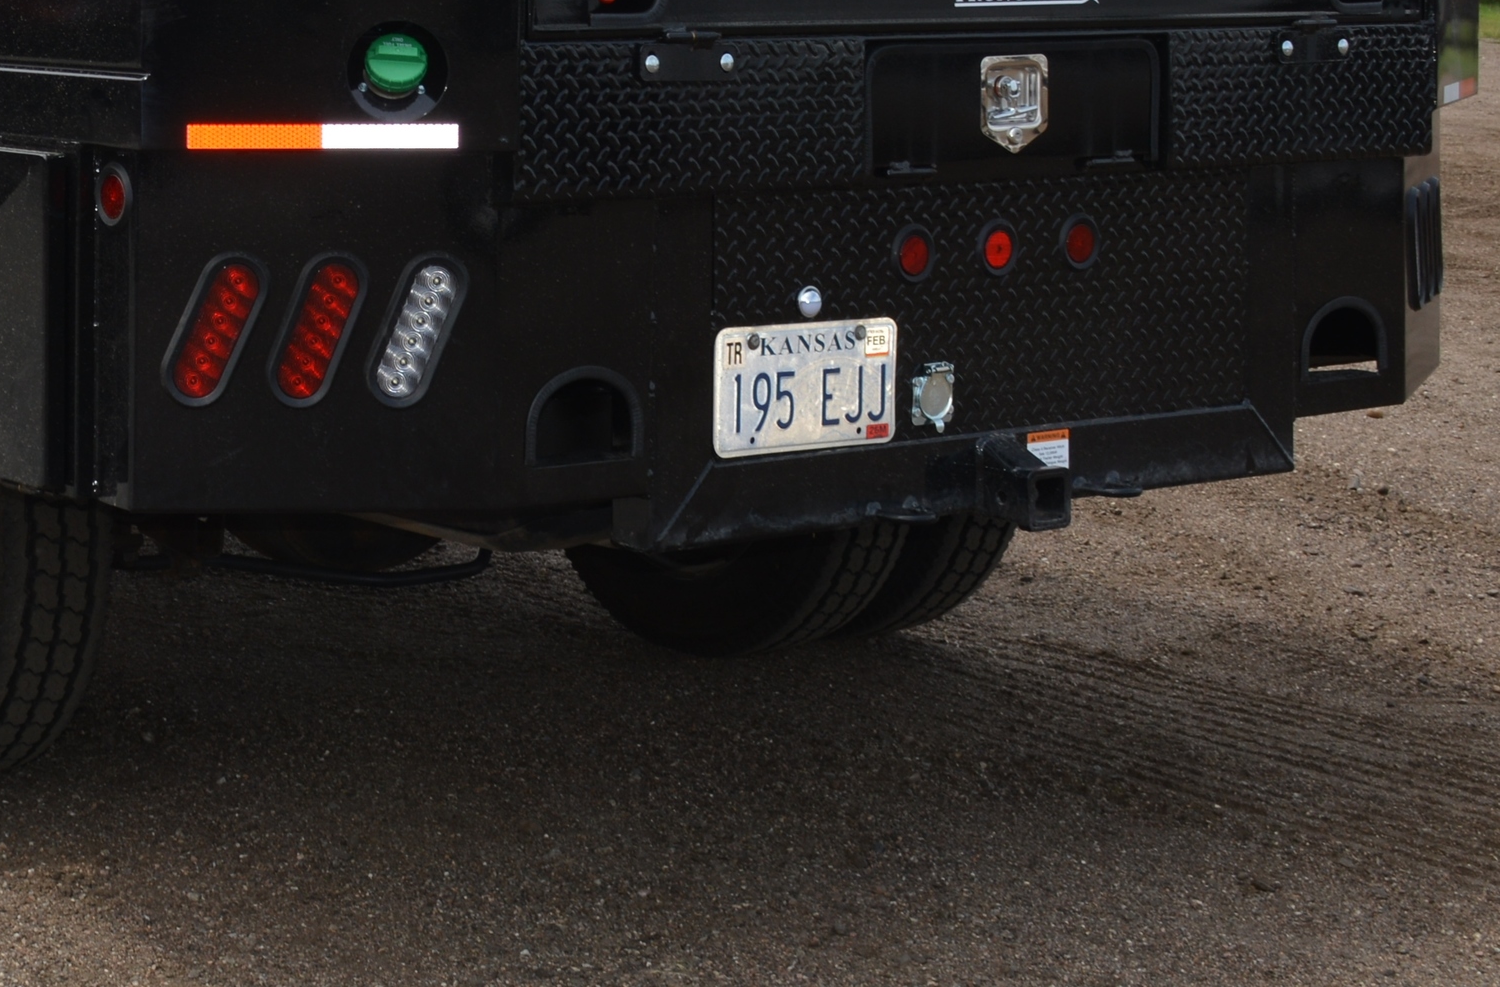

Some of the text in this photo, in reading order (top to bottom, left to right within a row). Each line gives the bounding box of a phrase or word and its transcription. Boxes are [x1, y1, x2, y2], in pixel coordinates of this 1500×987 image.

[760, 330, 856, 357] KANSAS
[866, 334, 886, 346] FEB
[726, 342, 742, 365] TR
[734, 363, 887, 434] 195 EJJ
